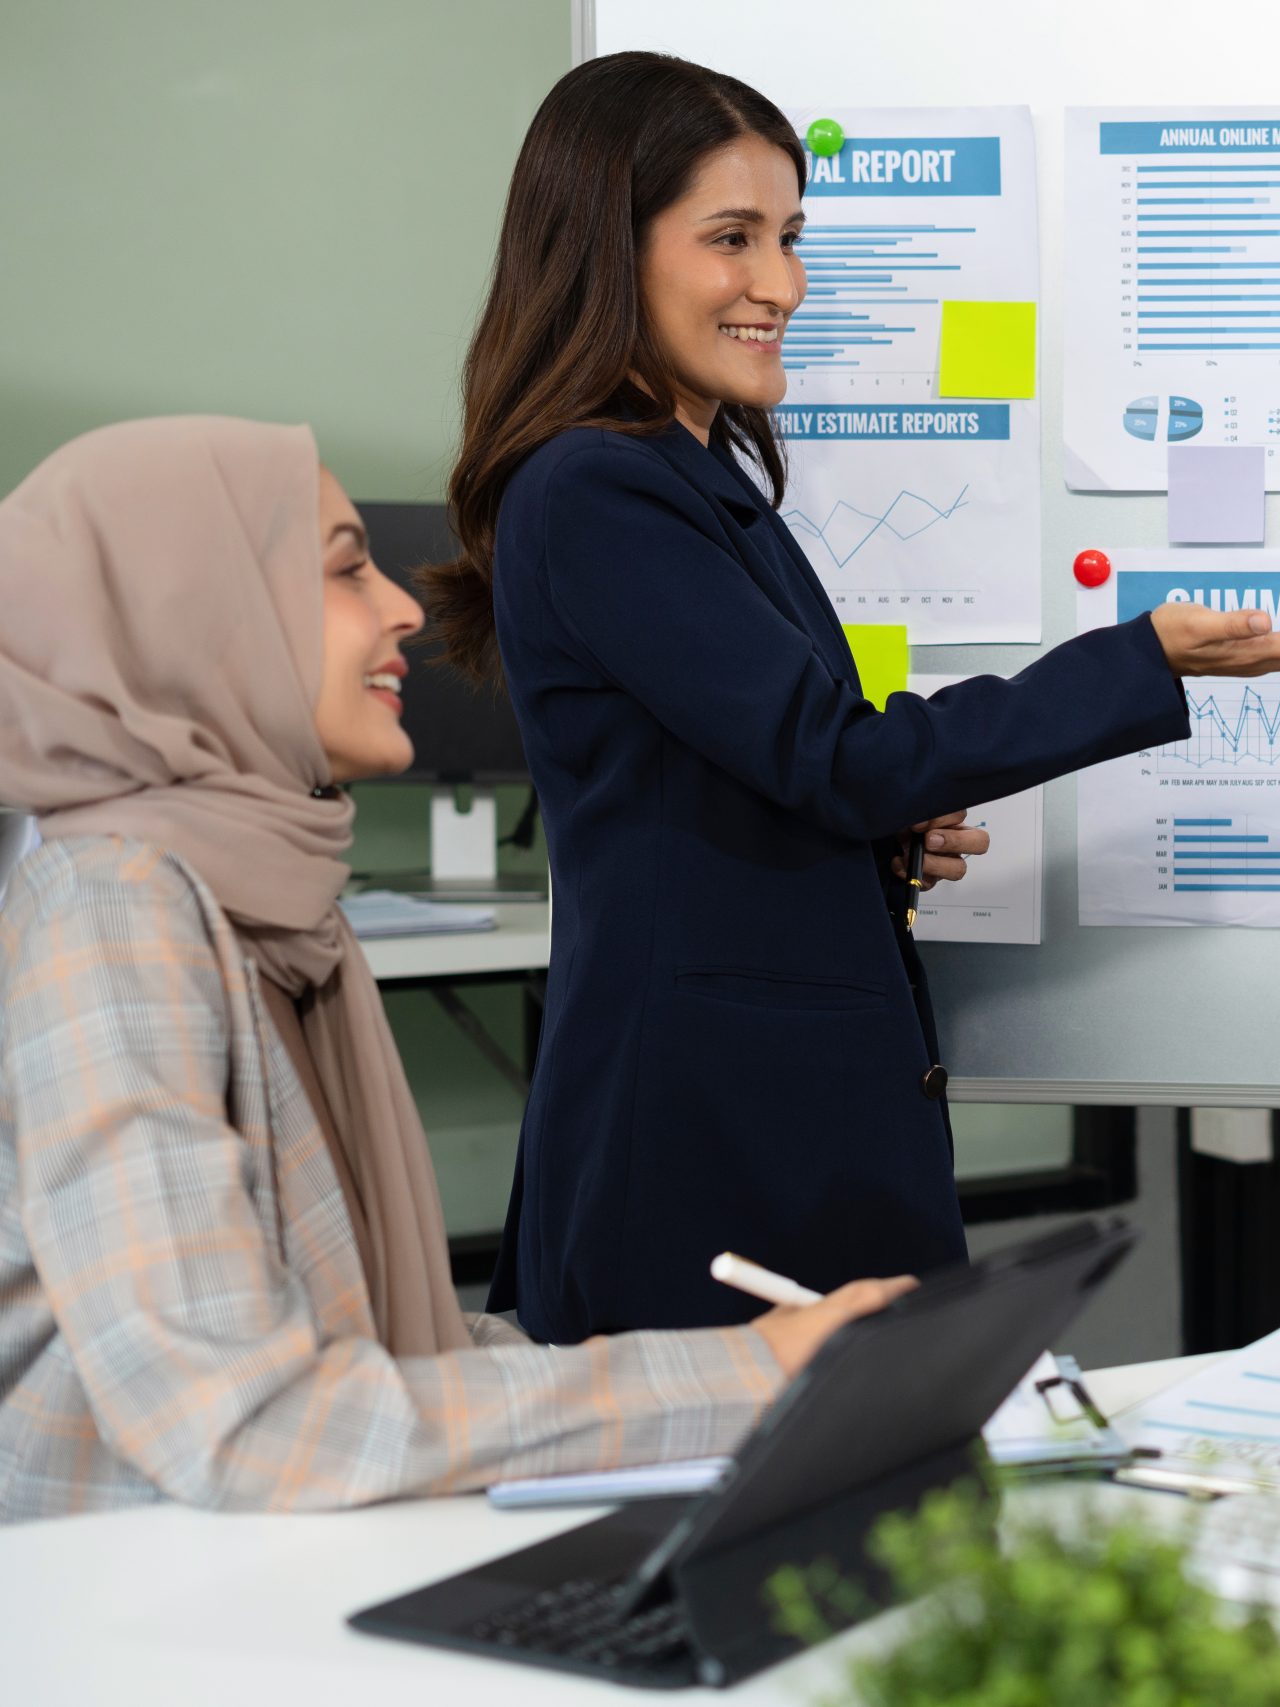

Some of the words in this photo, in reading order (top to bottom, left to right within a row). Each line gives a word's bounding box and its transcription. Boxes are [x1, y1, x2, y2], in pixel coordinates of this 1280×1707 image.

[1160, 128, 1217, 147] ANNUAL
[1219, 128, 1270, 146] ONLINE
[852, 149, 957, 184] REPORT
[817, 412, 899, 434] ESTIMATE
[902, 412, 980, 434] REPORTS
